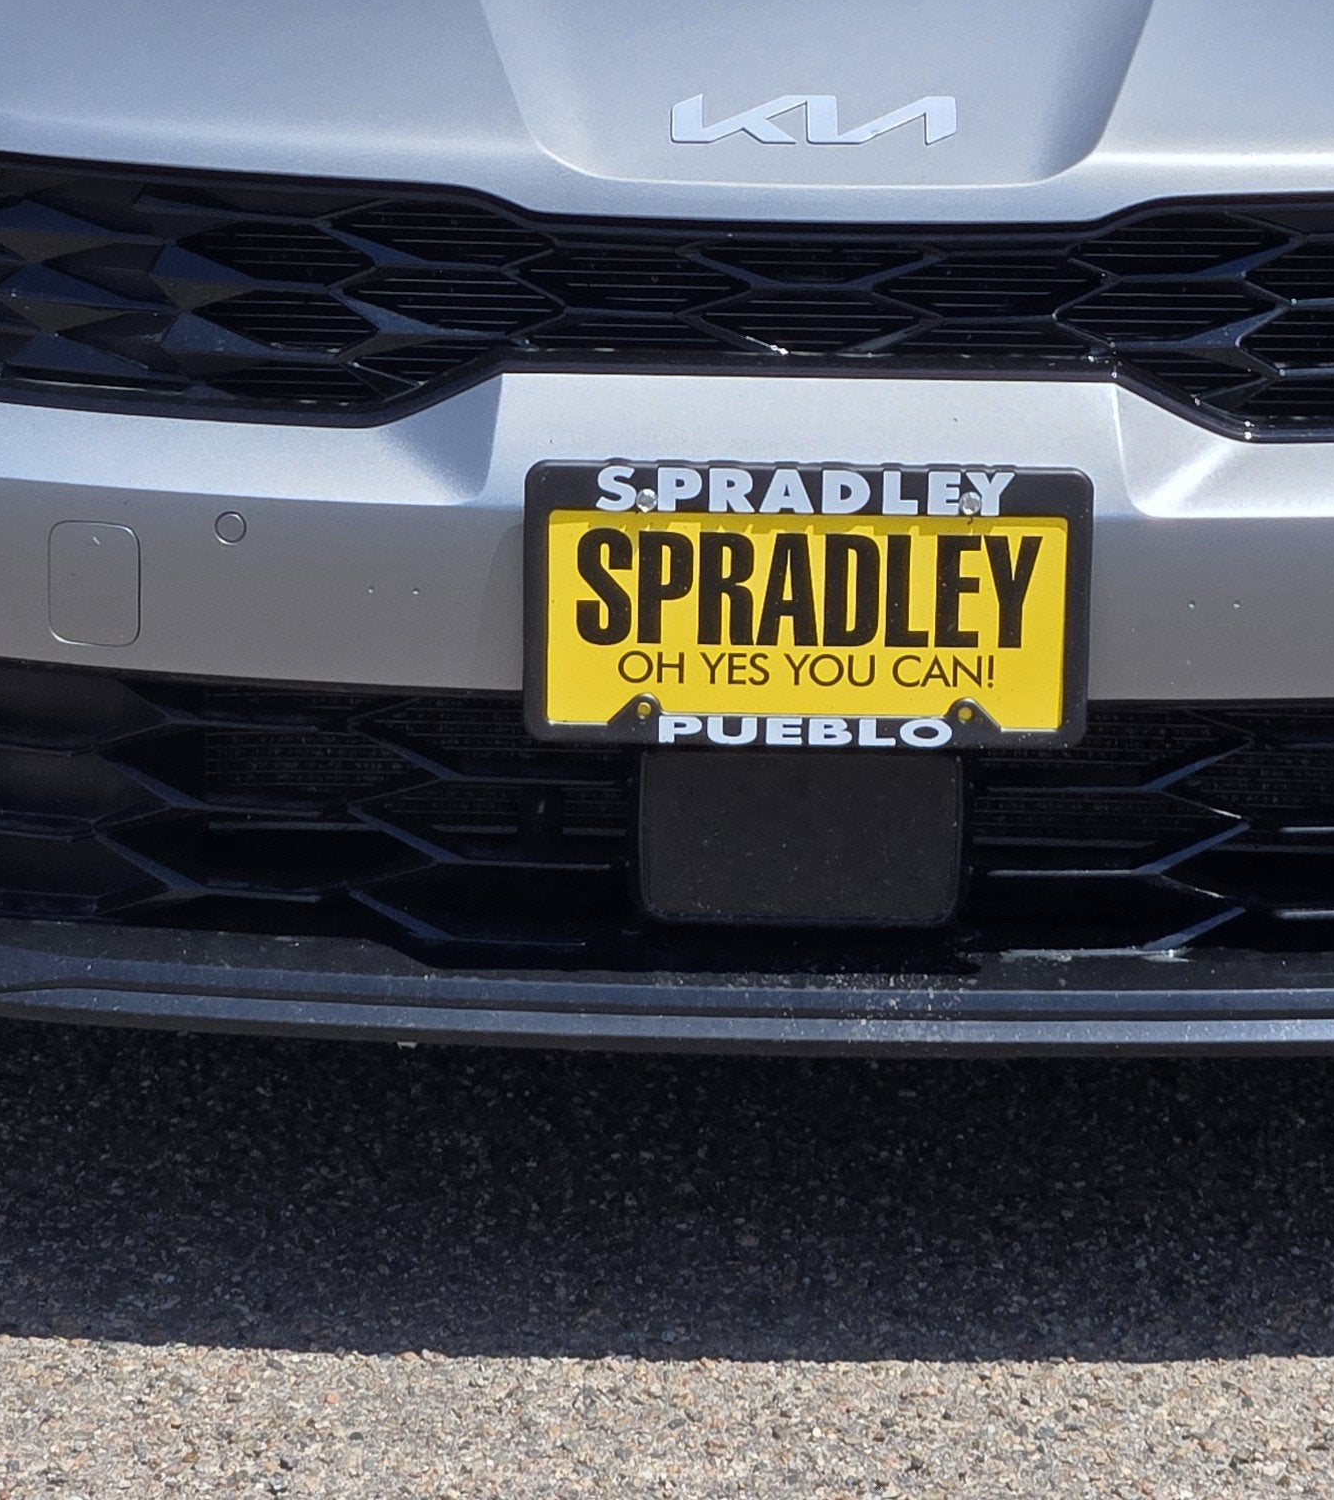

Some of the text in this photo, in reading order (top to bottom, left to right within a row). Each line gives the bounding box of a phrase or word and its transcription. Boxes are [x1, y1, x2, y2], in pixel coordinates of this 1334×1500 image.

[671, 93, 957, 145] KIA
[596, 465, 1016, 517] SPRADLEY
[575, 527, 1044, 649] SPRADLEY
[617, 650, 996, 690] OH YES YOU CAN!
[657, 715, 953, 748] PUEBLO
